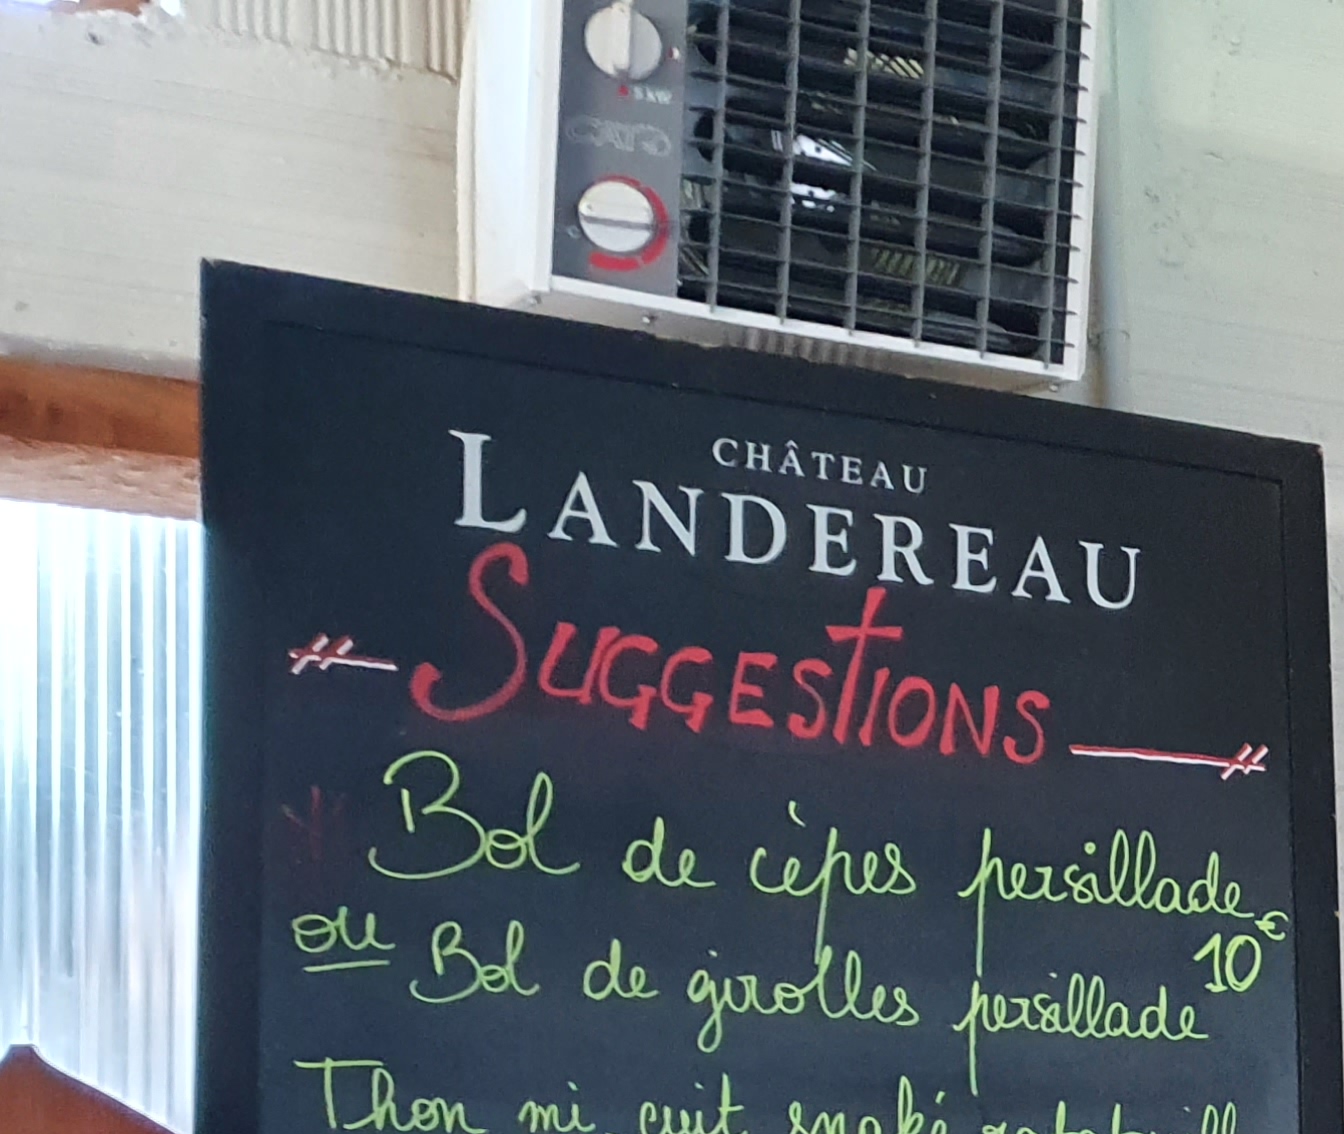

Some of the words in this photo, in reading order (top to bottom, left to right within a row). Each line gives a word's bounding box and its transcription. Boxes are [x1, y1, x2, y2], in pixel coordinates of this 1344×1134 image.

[448, 428, 1142, 612] LANDEREAU
[711, 435, 928, 495] CHÂTEAU
[367, 749, 581, 877] Bol
[622, 815, 717, 888] de
[749, 801, 919, 976] cèpes
[957, 823, 1255, 980] persillade
[290, 908, 395, 955] ou
[409, 920, 540, 1004] Bol
[583, 938, 659, 1000] de
[686, 943, 922, 1052] girolles
[953, 968, 1209, 1094] persillade
